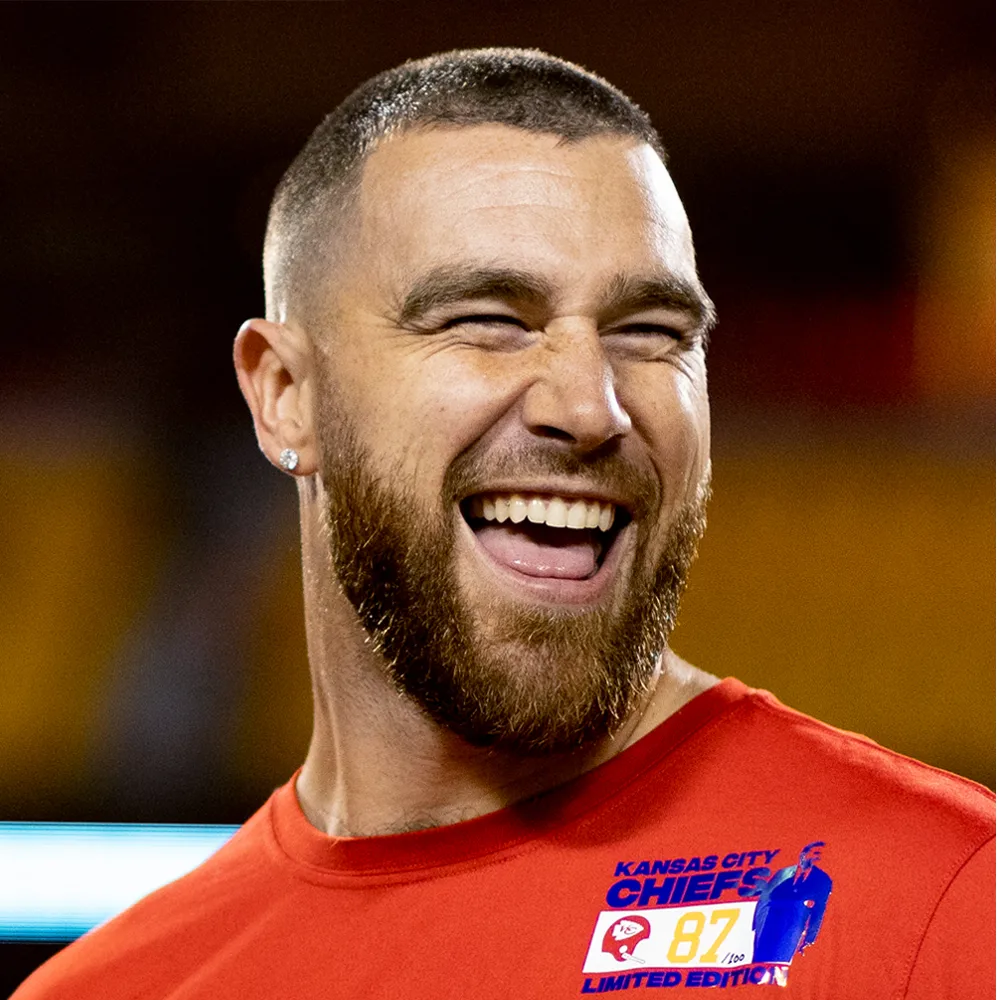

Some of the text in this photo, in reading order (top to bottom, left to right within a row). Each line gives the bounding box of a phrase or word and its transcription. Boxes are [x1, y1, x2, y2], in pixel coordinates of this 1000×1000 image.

[614, 849, 781, 877] KANSAS CITY
[606, 867, 772, 909] CHIEFS
[666, 908, 741, 964] 87
[721, 952, 746, 965] /100
[581, 966, 789, 994] LIMITED EDITION
